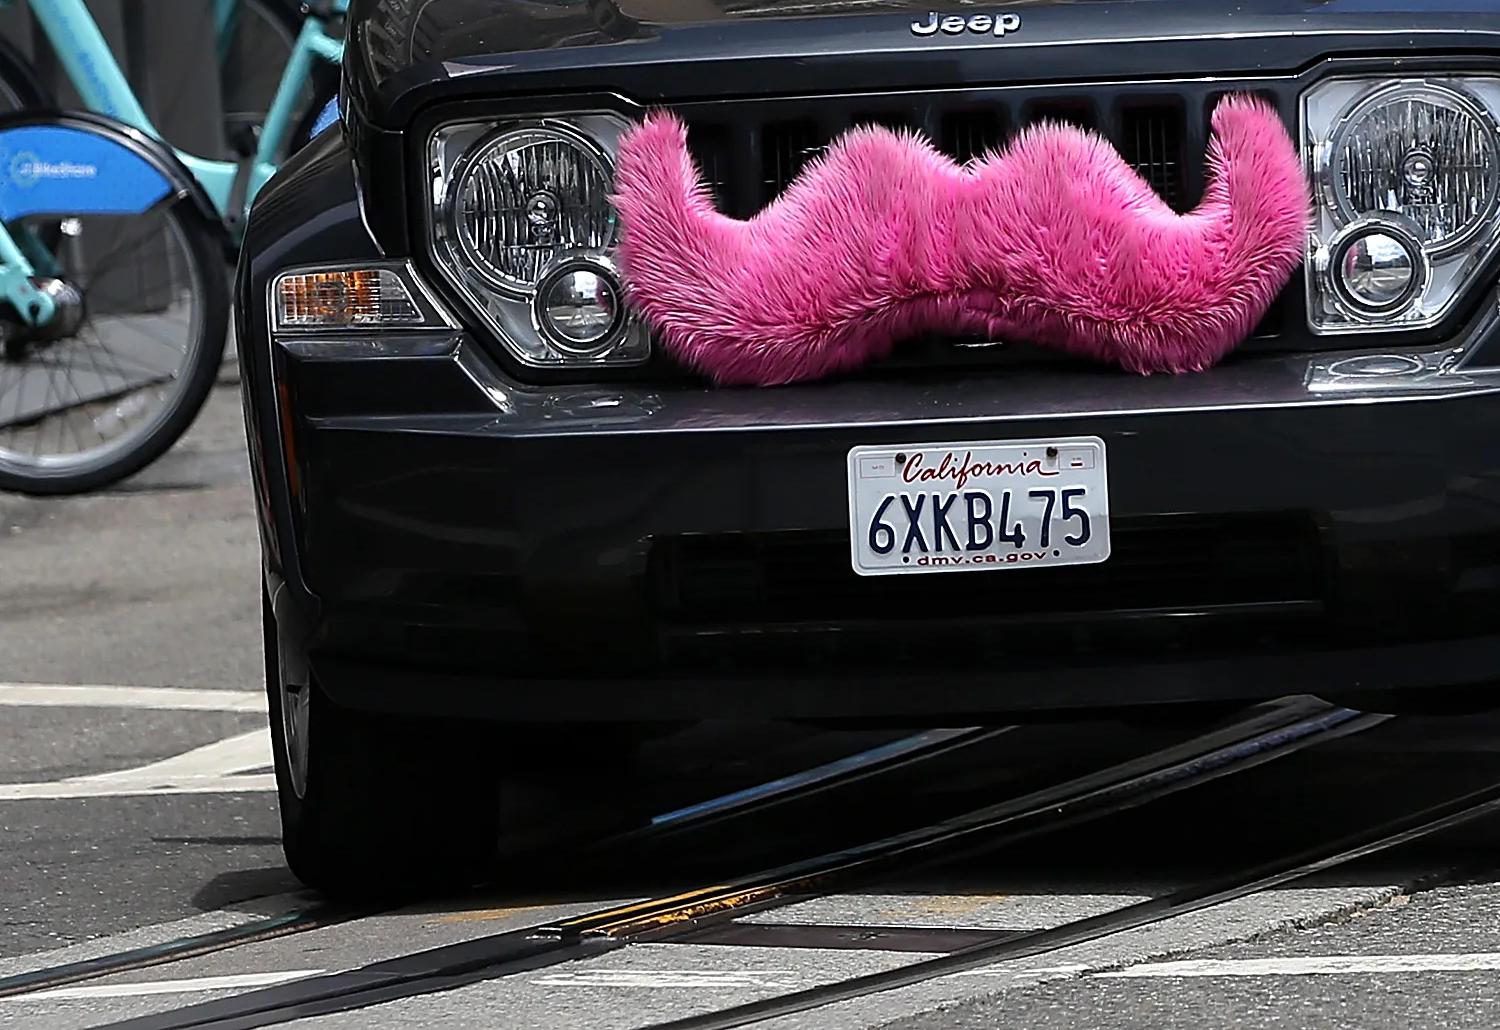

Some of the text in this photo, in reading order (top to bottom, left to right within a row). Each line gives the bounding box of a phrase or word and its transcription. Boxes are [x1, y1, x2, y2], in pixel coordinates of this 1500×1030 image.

[910, 11, 1022, 37] Jeep
[903, 451, 1060, 489] California
[868, 488, 1091, 555] 6XKB475
[917, 550, 1047, 567] dmv.ca.gov
